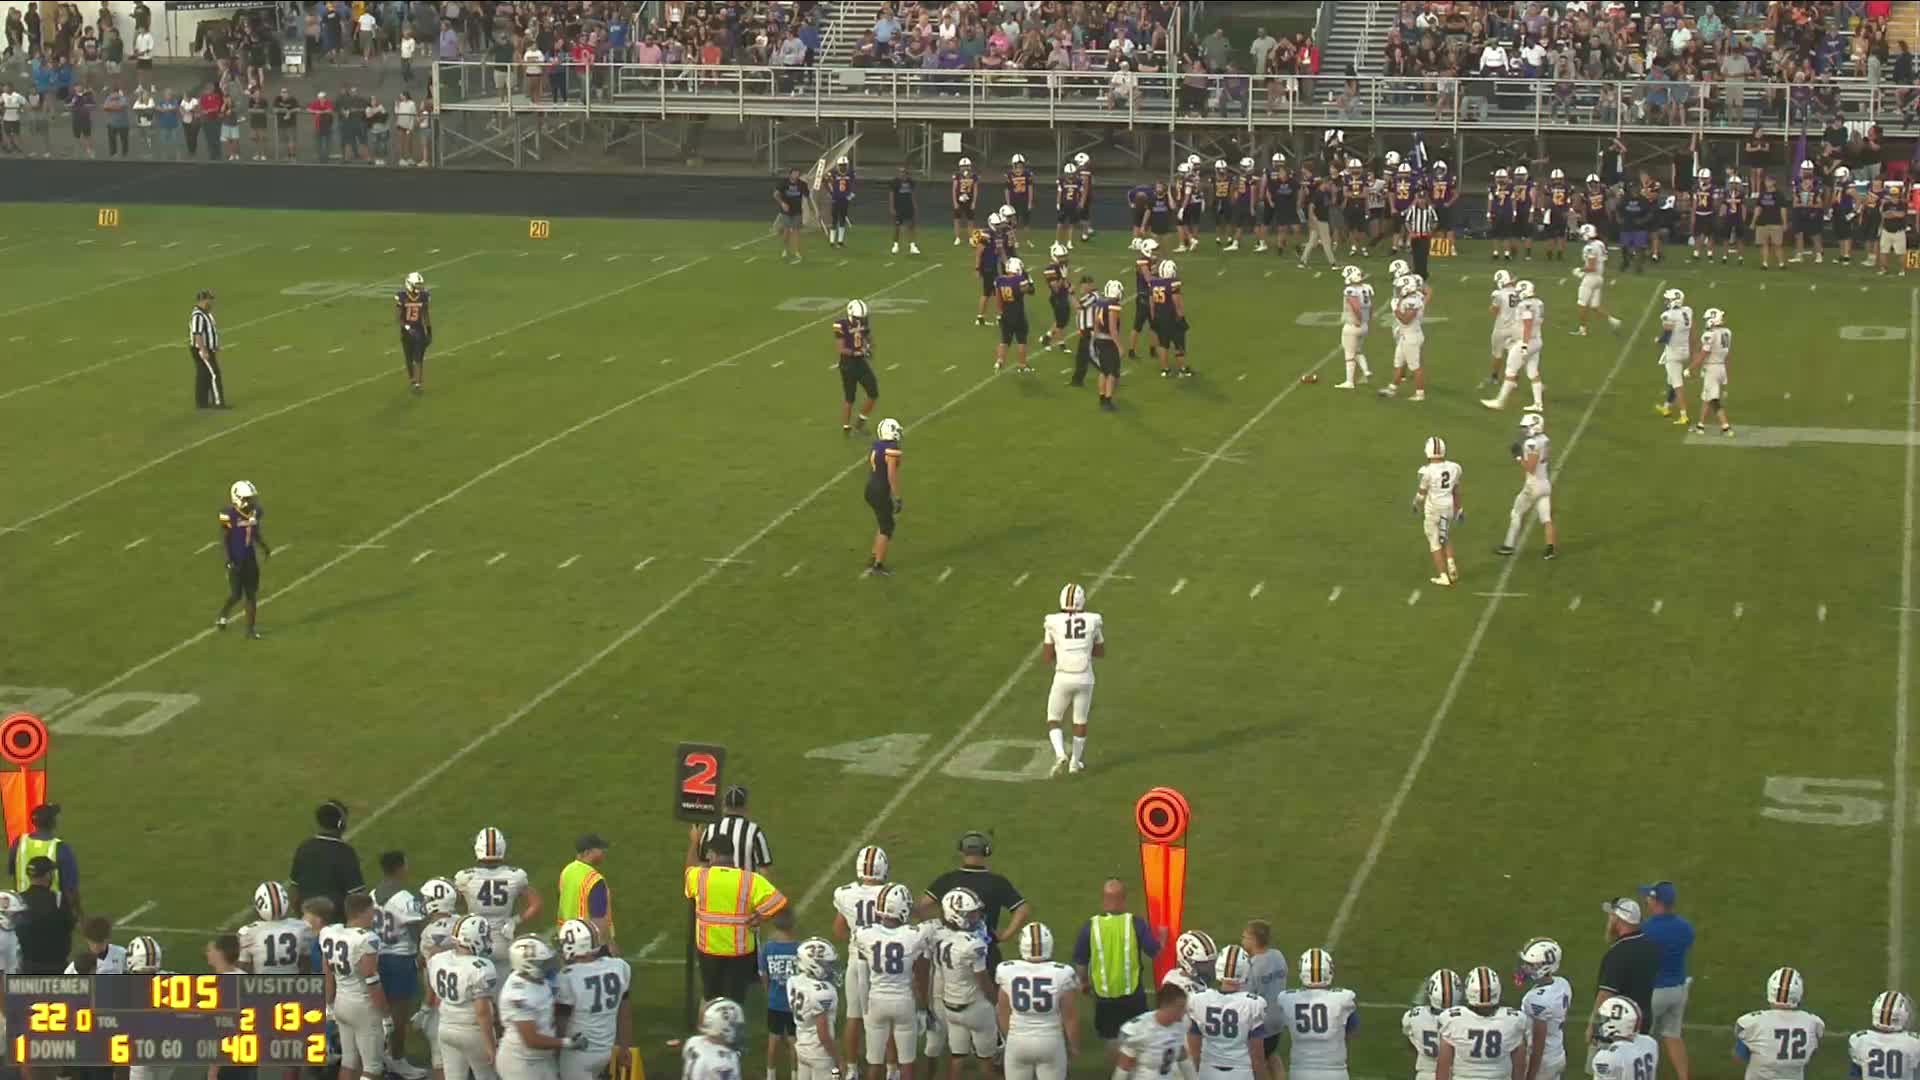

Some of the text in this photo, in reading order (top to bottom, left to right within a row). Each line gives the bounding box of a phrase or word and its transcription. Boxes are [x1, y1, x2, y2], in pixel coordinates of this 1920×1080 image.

[531, 221, 548, 237] 20
[1440, 471, 1451, 489] 2
[1064, 618, 1086, 640] 12
[683, 752, 718, 796] 2
[1759, 776, 1920, 826] 5
[477, 879, 509, 907] 45
[264, 932, 298, 967] 13
[871, 940, 905, 975] 18
[436, 967, 460, 1002] 68
[584, 972, 621, 1014] 79
[1011, 975, 1054, 1013] 65
[1204, 1006, 1239, 1039] 58
[1294, 1003, 1329, 1033] 50
[1467, 1029, 1502, 1058] 78
[1773, 1028, 1808, 1061] 72
[1867, 1048, 1903, 1079] 20
